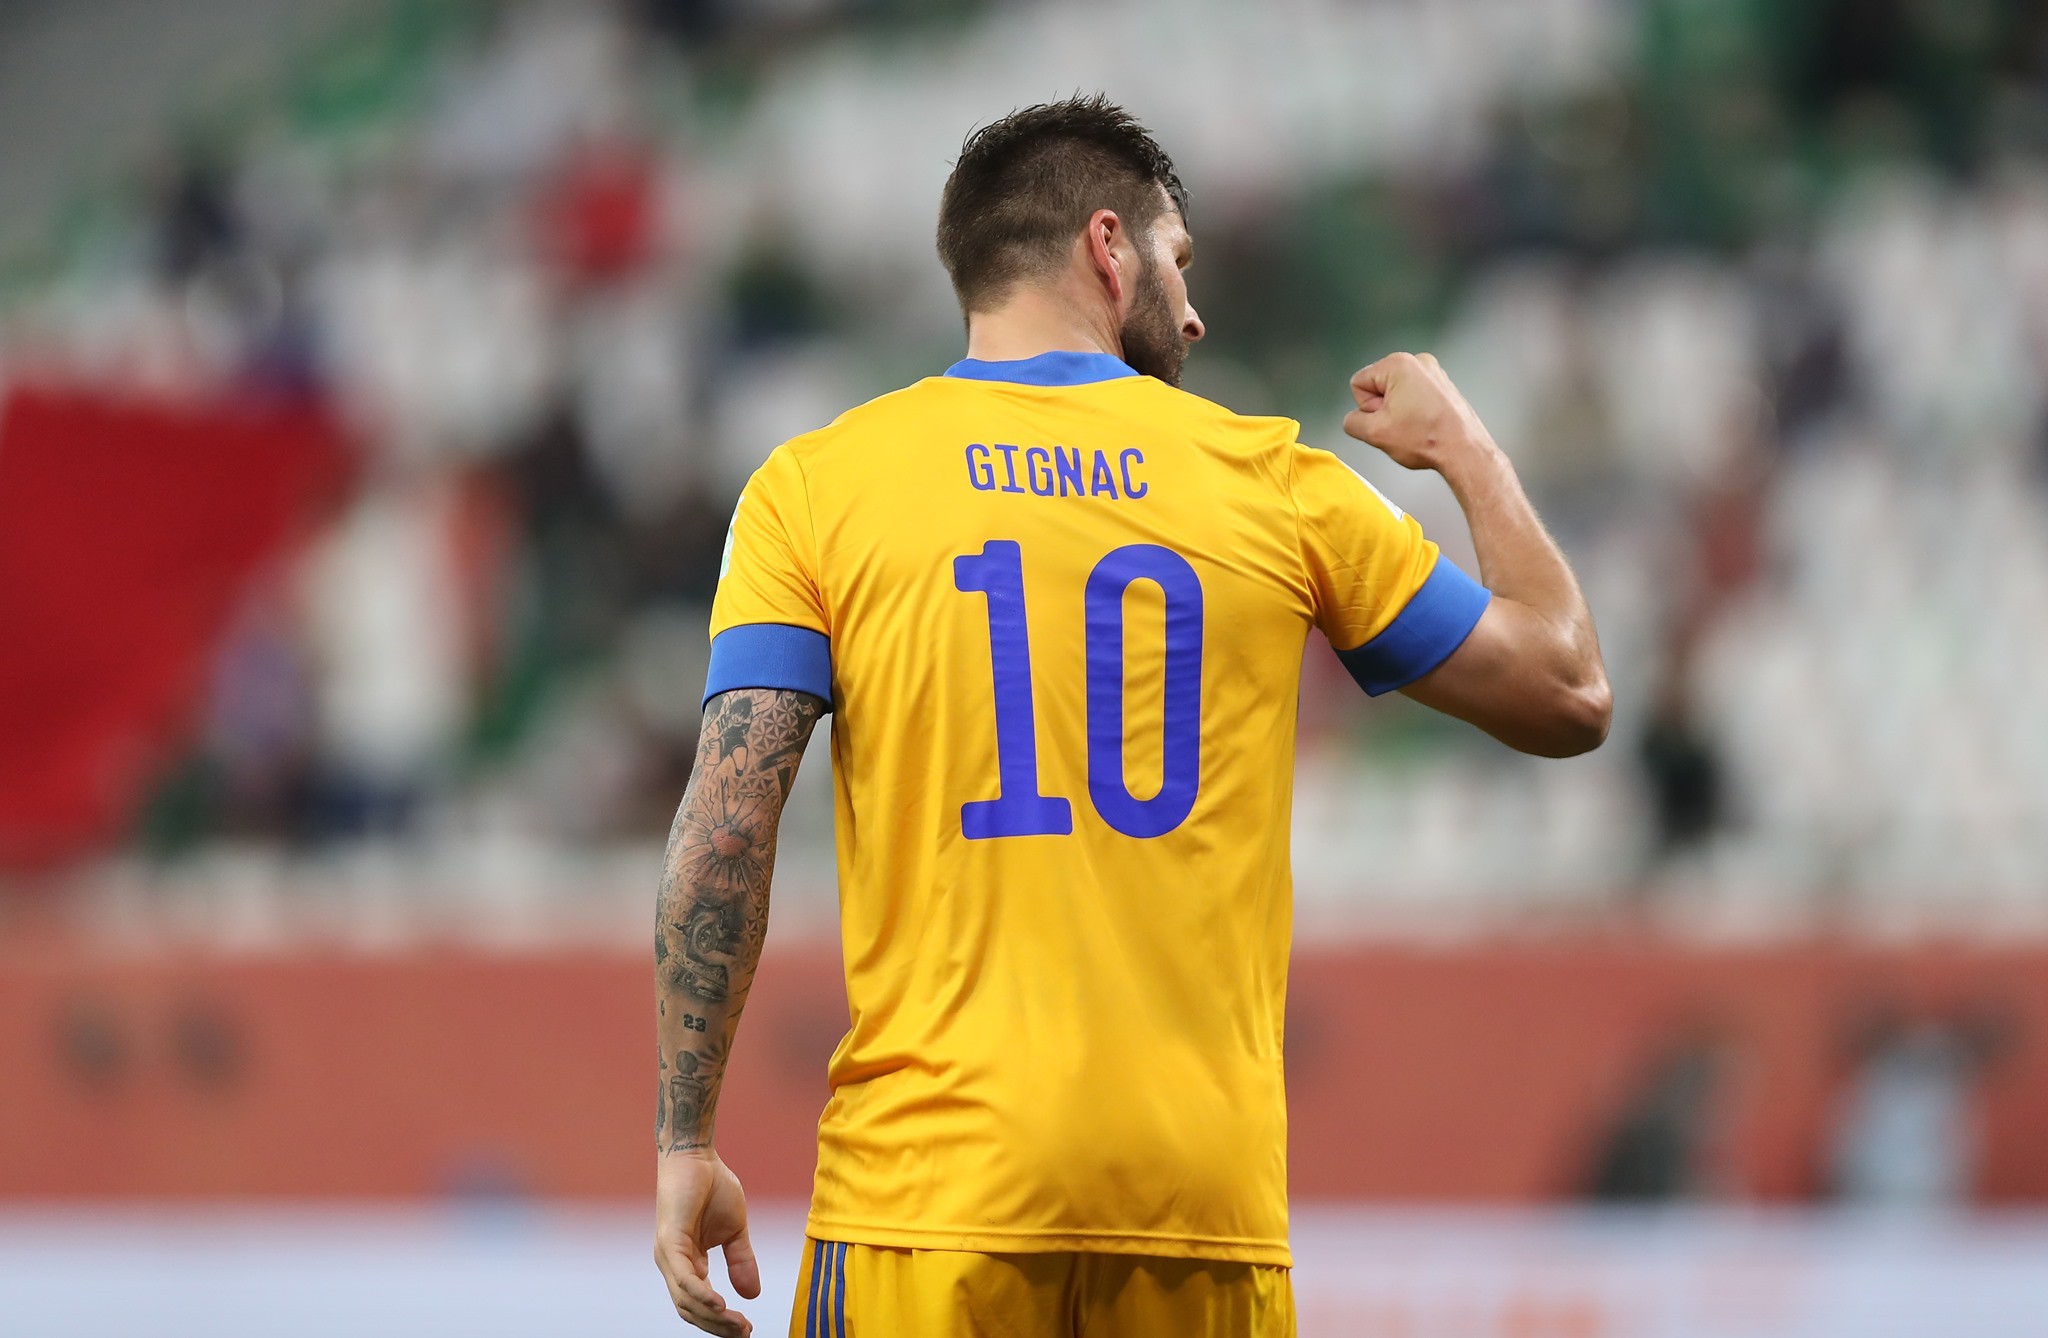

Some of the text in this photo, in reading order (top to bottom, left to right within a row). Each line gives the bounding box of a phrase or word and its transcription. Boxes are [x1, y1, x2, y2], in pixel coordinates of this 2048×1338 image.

[966, 444, 1148, 499] GIGNAC
[953, 540, 1203, 839] 10
[683, 1014, 706, 1032] 23
